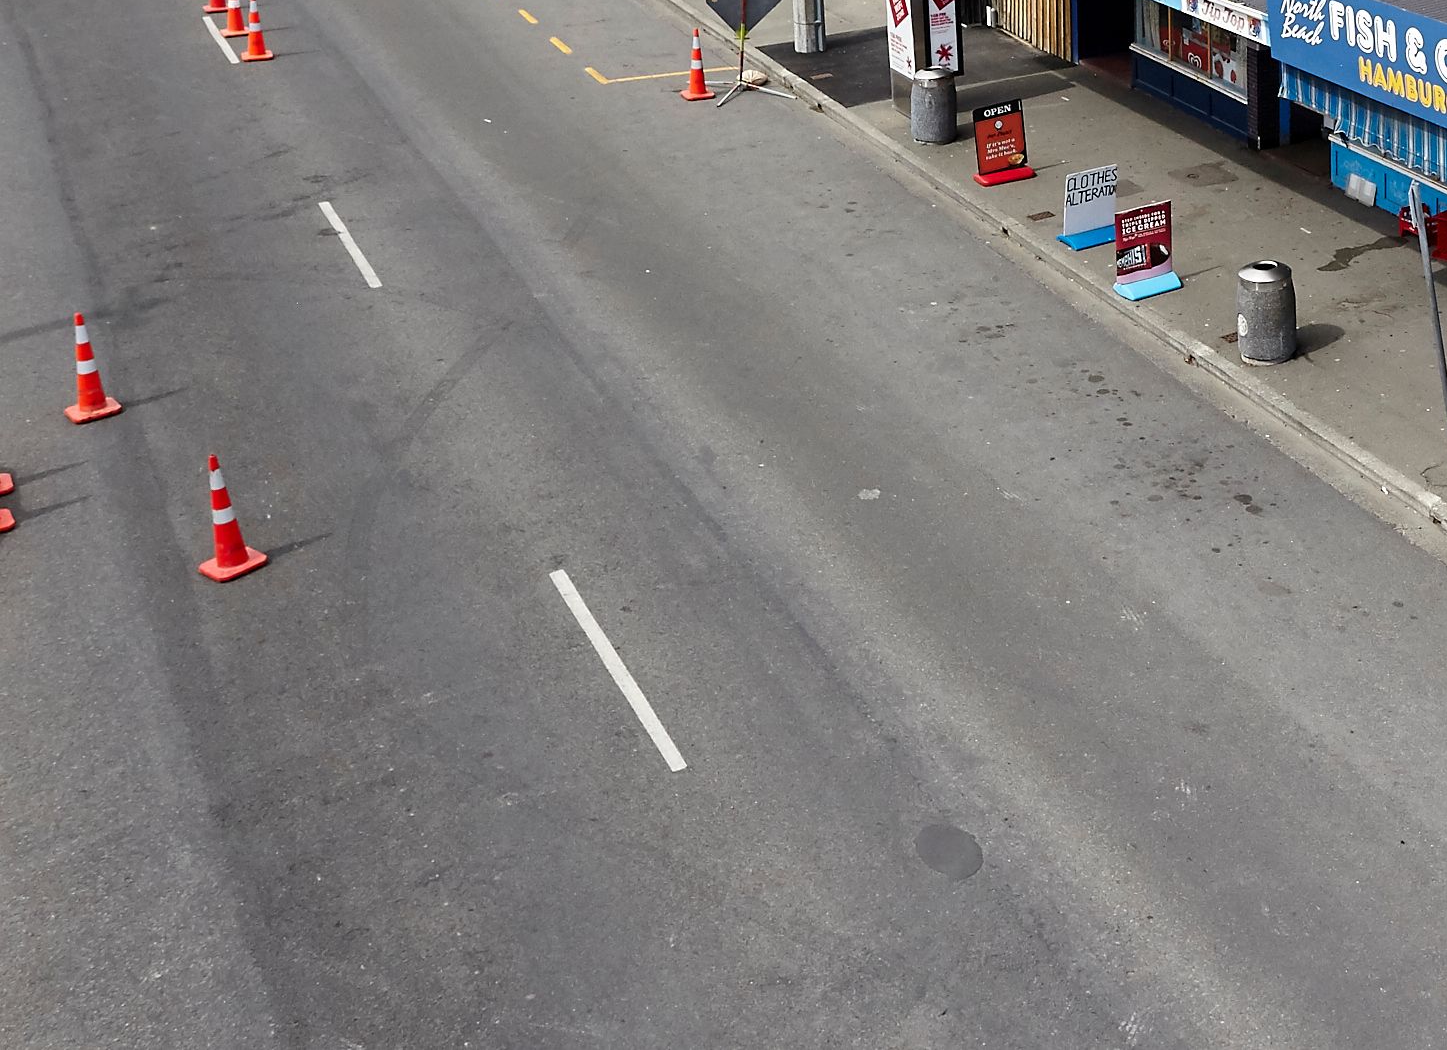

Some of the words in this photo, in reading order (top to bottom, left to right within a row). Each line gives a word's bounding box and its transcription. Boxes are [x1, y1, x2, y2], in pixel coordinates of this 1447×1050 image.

[1281, 12, 1325, 45] Beach
[1328, 0, 1397, 63] FISH
[1405, 26, 1428, 75] &
[983, 103, 1012, 118] OPEN
[1067, 167, 1118, 192] CLOTHES
[1065, 185, 1118, 207] ALTERATIO
[1121, 225, 1137, 235] ICE
[1137, 219, 1166, 231] CREAM
